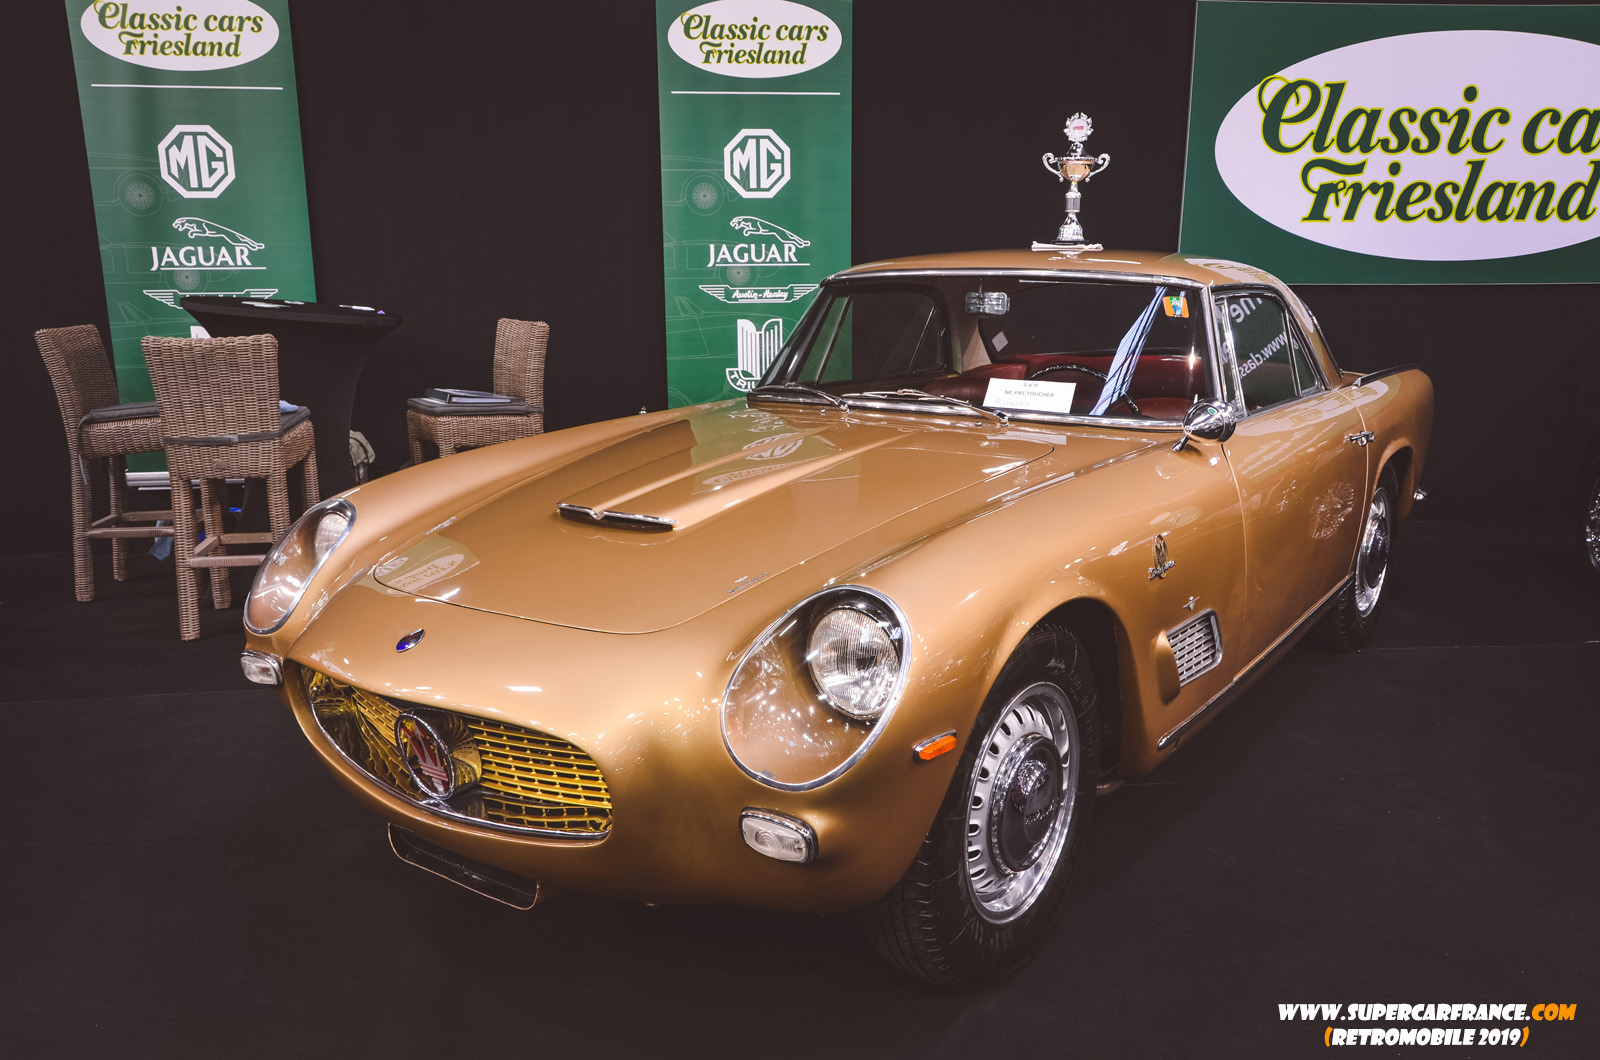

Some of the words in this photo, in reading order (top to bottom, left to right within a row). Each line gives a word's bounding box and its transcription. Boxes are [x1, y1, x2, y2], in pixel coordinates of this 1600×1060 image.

[93, 0, 198, 31] Classic
[203, 13, 264, 34] cars
[680, 11, 771, 41] Classic
[775, 21, 829, 42] cars
[118, 30, 242, 58] Friesland
[699, 41, 808, 66] Friesland
[1257, 74, 1512, 156] Classic
[167, 133, 226, 190] MG
[730, 137, 783, 191] MG
[1300, 158, 1597, 224] Friesland
[150, 246, 252, 271] JAGUAR
[707, 243, 798, 268] JAGUAR
